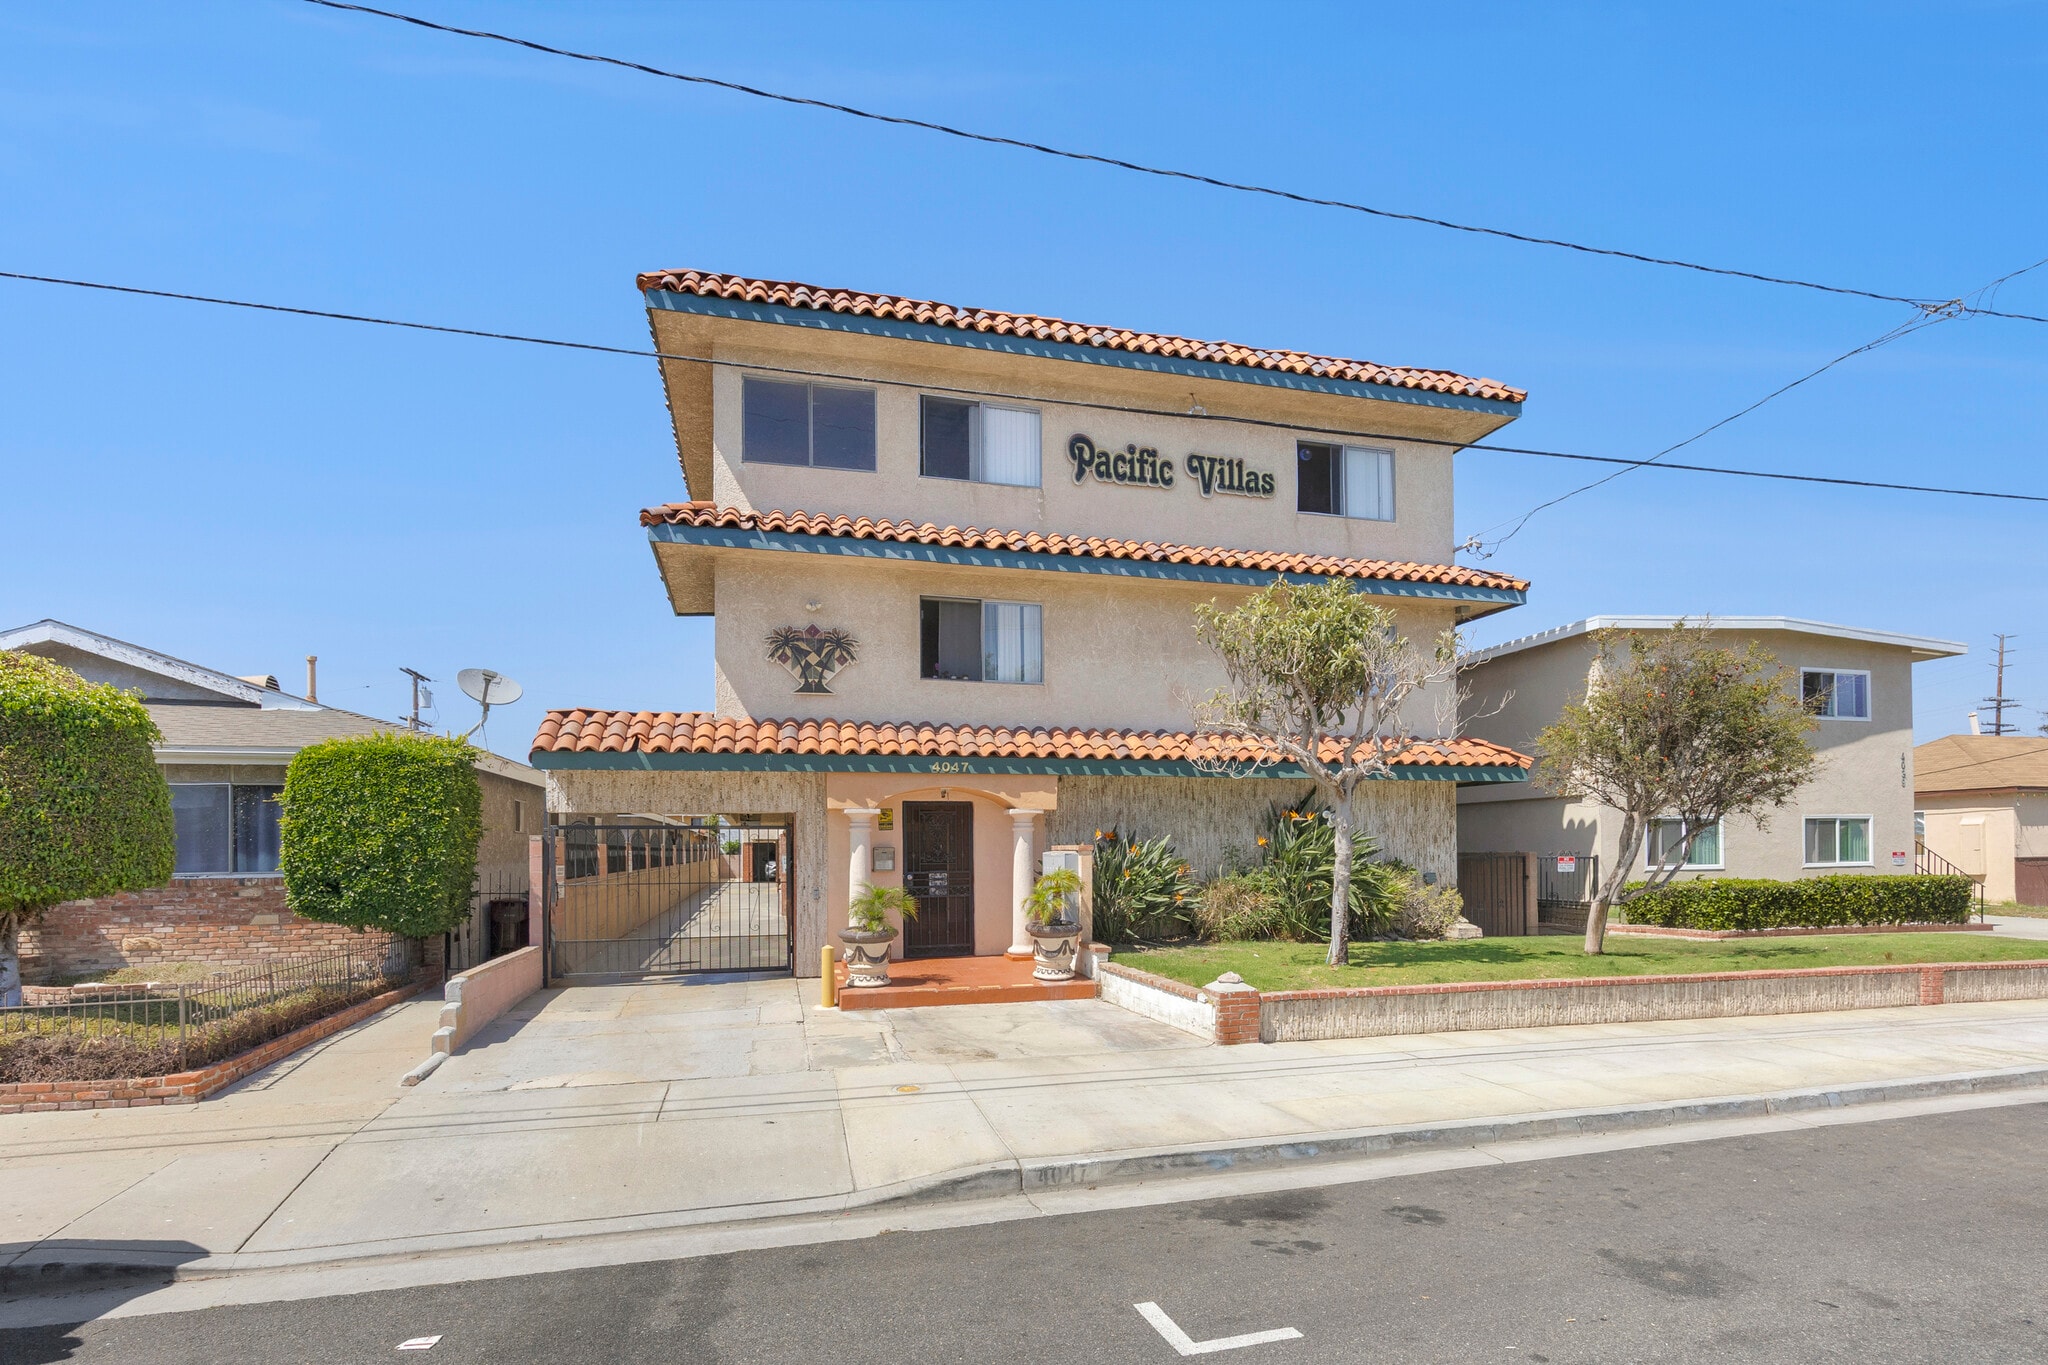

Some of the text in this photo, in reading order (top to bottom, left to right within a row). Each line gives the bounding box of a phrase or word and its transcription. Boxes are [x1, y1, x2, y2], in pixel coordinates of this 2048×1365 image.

[1068, 434, 1276, 497] Pacific Villas
[931, 761, 969, 773] 4047
